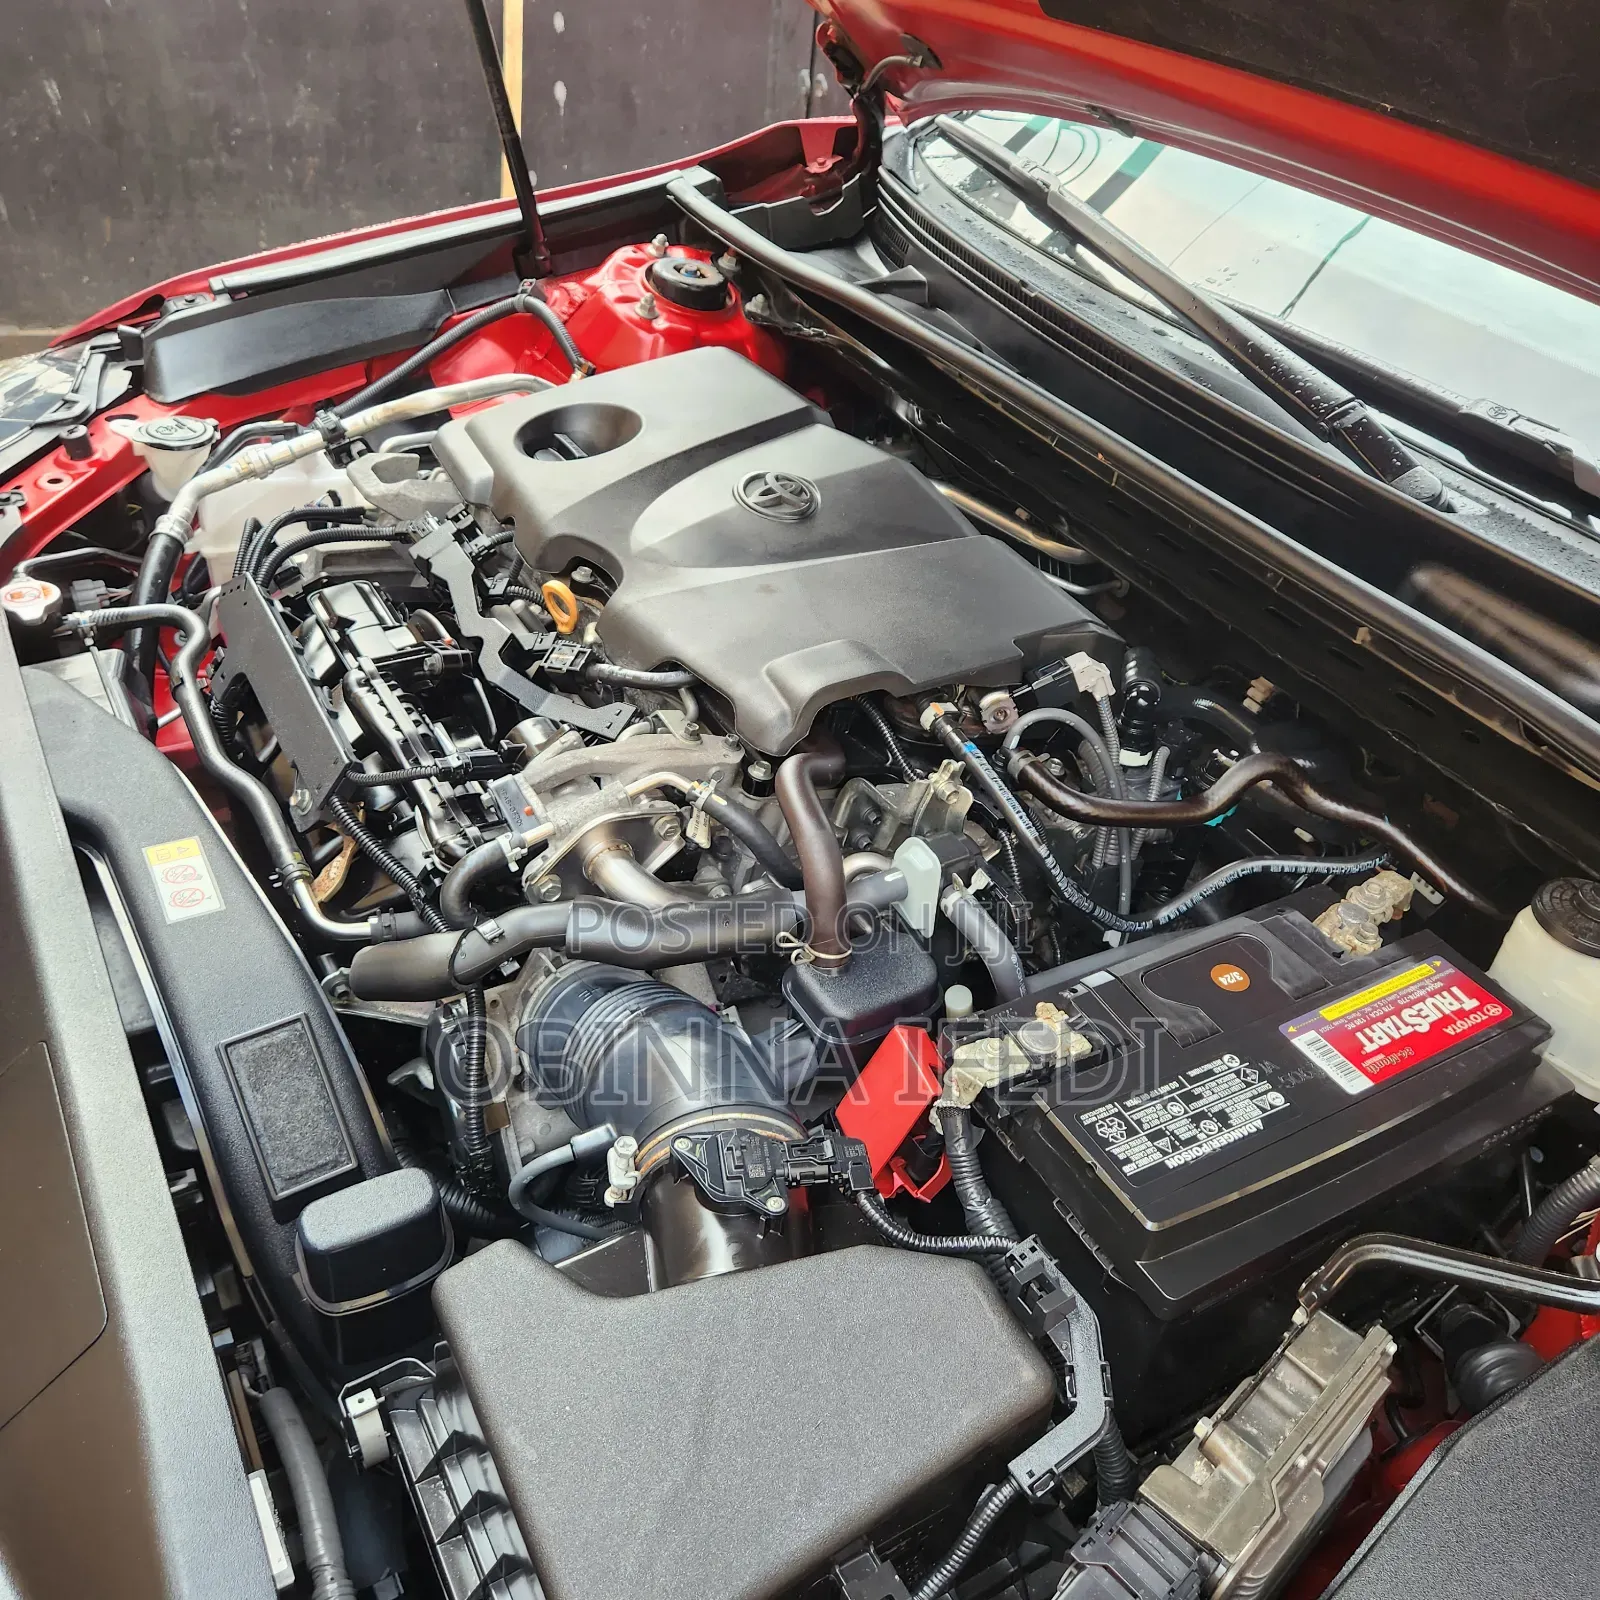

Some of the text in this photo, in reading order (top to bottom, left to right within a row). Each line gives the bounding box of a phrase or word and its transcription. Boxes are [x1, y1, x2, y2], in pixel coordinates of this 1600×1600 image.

[1218, 971, 1244, 986] 3/24
[1368, 1008, 1383, 1017] CCA
[1344, 1021, 1355, 1029] RC
[1443, 1011, 1489, 1036] TOYOTA
[1157, 1084, 1170, 1093] NOT
[1096, 1107, 1118, 1119] BATTERY
[1140, 1112, 1158, 1122] REACH
[1159, 1113, 1172, 1122] KEEP
[1163, 1124, 1246, 1169] DANGER/POISON
[1129, 1150, 1147, 1161] CAUSE
[1122, 1151, 1162, 1172] SULFURIC ACID
